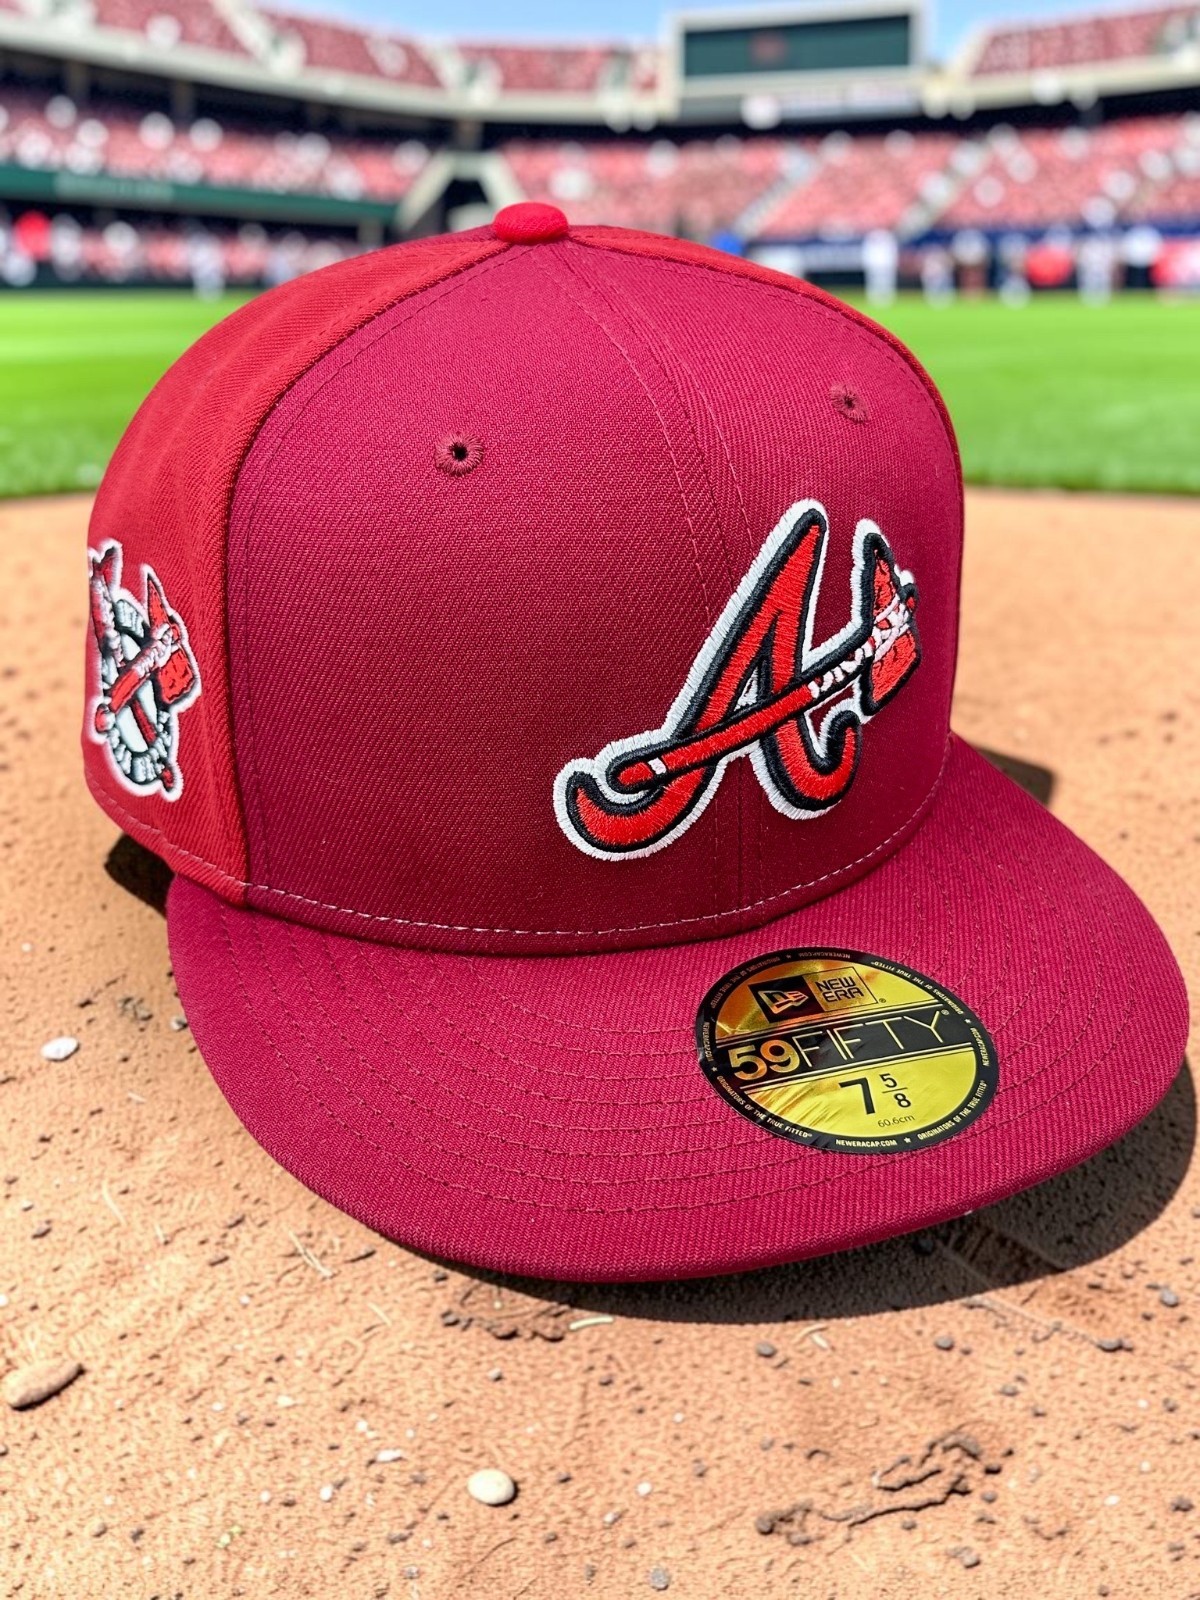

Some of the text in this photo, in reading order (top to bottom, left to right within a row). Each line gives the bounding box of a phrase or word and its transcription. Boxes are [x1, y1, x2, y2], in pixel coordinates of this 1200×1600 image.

[897, 969, 912, 979] TRUE
[912, 977, 924, 986] THE
[815, 976, 856, 992] NEW
[822, 987, 864, 1003] ERA
[717, 1075, 746, 1105] ORIGINATORS
[753, 1110, 767, 1120] THE
[766, 1118, 784, 1129] TRUE
[838, 1073, 912, 1115] 7 5 8
[877, 1113, 916, 1128] 60.6cm
[917, 1120, 956, 1140] ORIGINATORS
[953, 1114, 961, 1123] OF
[959, 1107, 972, 1118] THE
[967, 1096, 981, 1108] TRUE
[835, 1138, 898, 1148] NEWERACAP.COM
